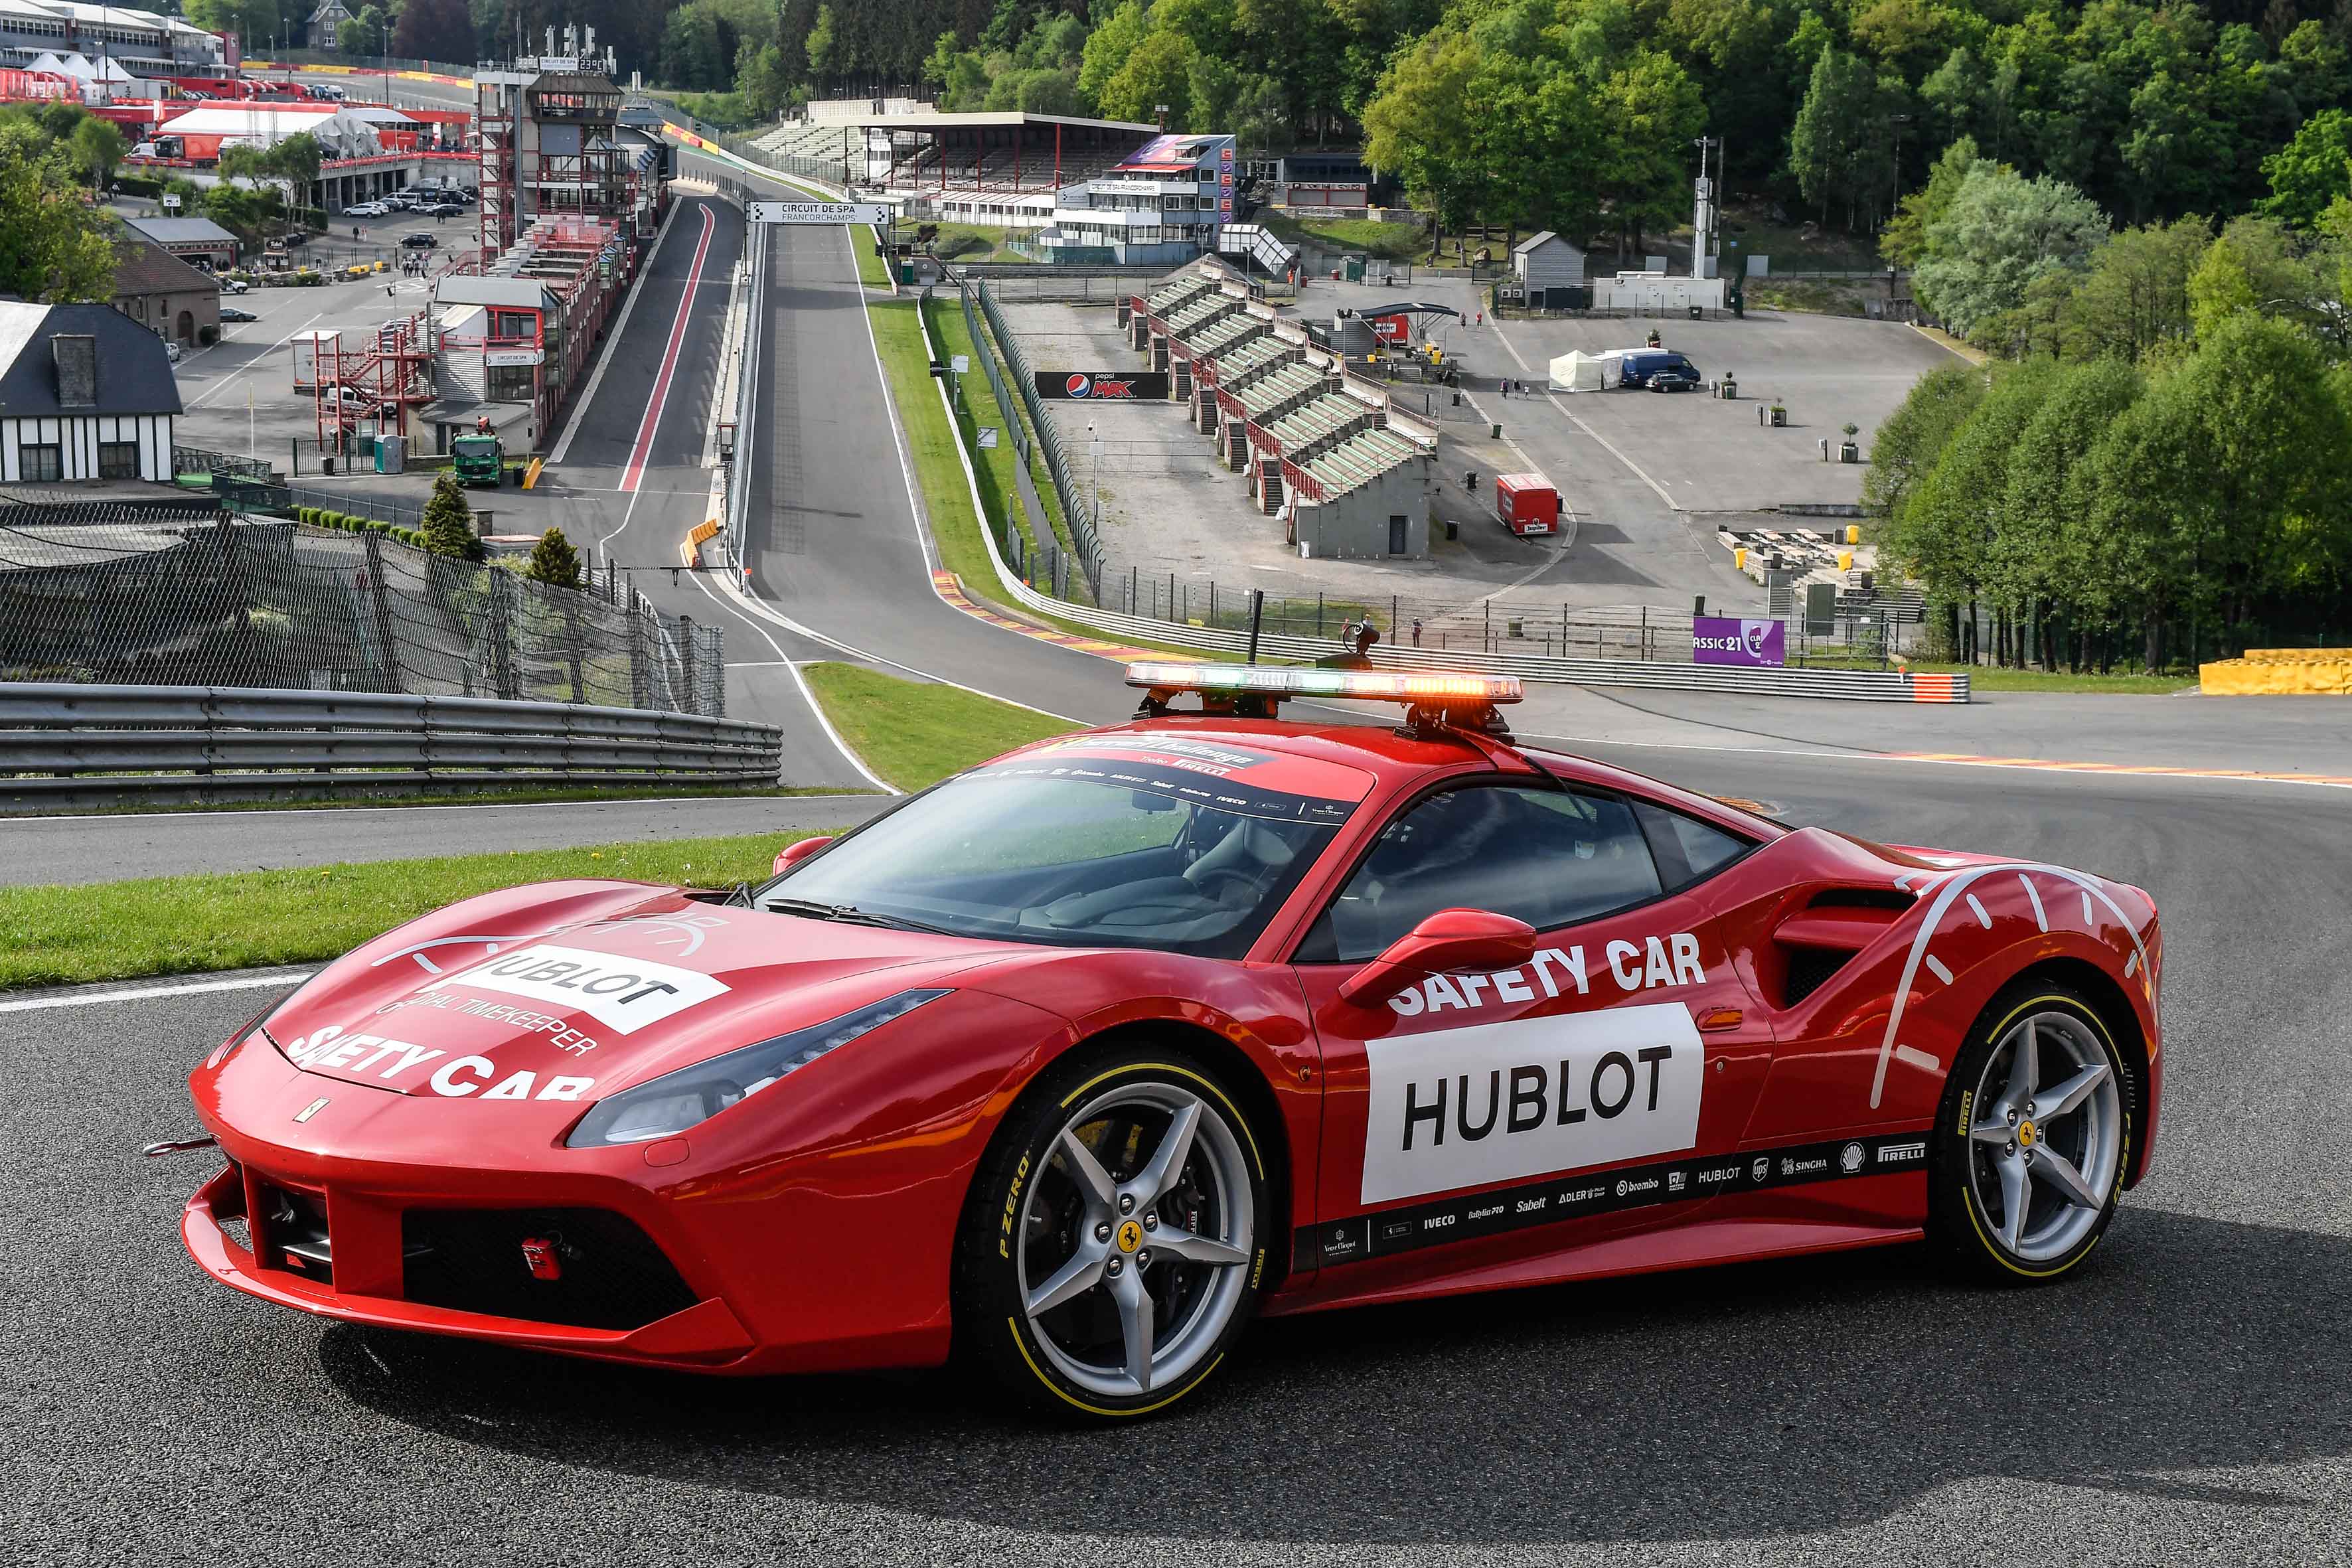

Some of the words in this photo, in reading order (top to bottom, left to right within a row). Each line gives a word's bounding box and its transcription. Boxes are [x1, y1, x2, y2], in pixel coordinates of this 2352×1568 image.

[782, 204, 819, 213] CIRCUIT
[822, 204, 834, 213] DE
[837, 205, 856, 214] SPA
[782, 213, 856, 222] FRANCORCHAMPS
[1091, 380, 1137, 398] MAX
[1693, 637, 1725, 650] ASSIC
[1726, 636, 1741, 651] 21
[1146, 740, 1254, 764] Challenge
[1172, 759, 1231, 776] PIRELLI
[1216, 795, 1247, 805] IVECO
[1605, 933, 1707, 991] CAR
[453, 998, 599, 1058] TIMEKEEPER
[1401, 1045, 1672, 1152] HUBLOT
[1958, 1089, 1972, 1137] PIRELLI
[1877, 1142, 1925, 1162] PIRELLI
[1753, 1163, 1767, 1178] ups
[1795, 1158, 1828, 1171] SINGHA
[1698, 1167, 1741, 1184] HUBLOT
[1628, 1178, 1659, 1192] brembo
[1002, 1157, 1030, 1235] ZERO
[1516, 1196, 1547, 1213] Sabelt
[1558, 1190, 1587, 1204] ADLER
[1491, 1205, 1504, 1215] PRO
[1424, 1214, 1456, 1229] IVECO
[998, 1238, 1009, 1259] P
